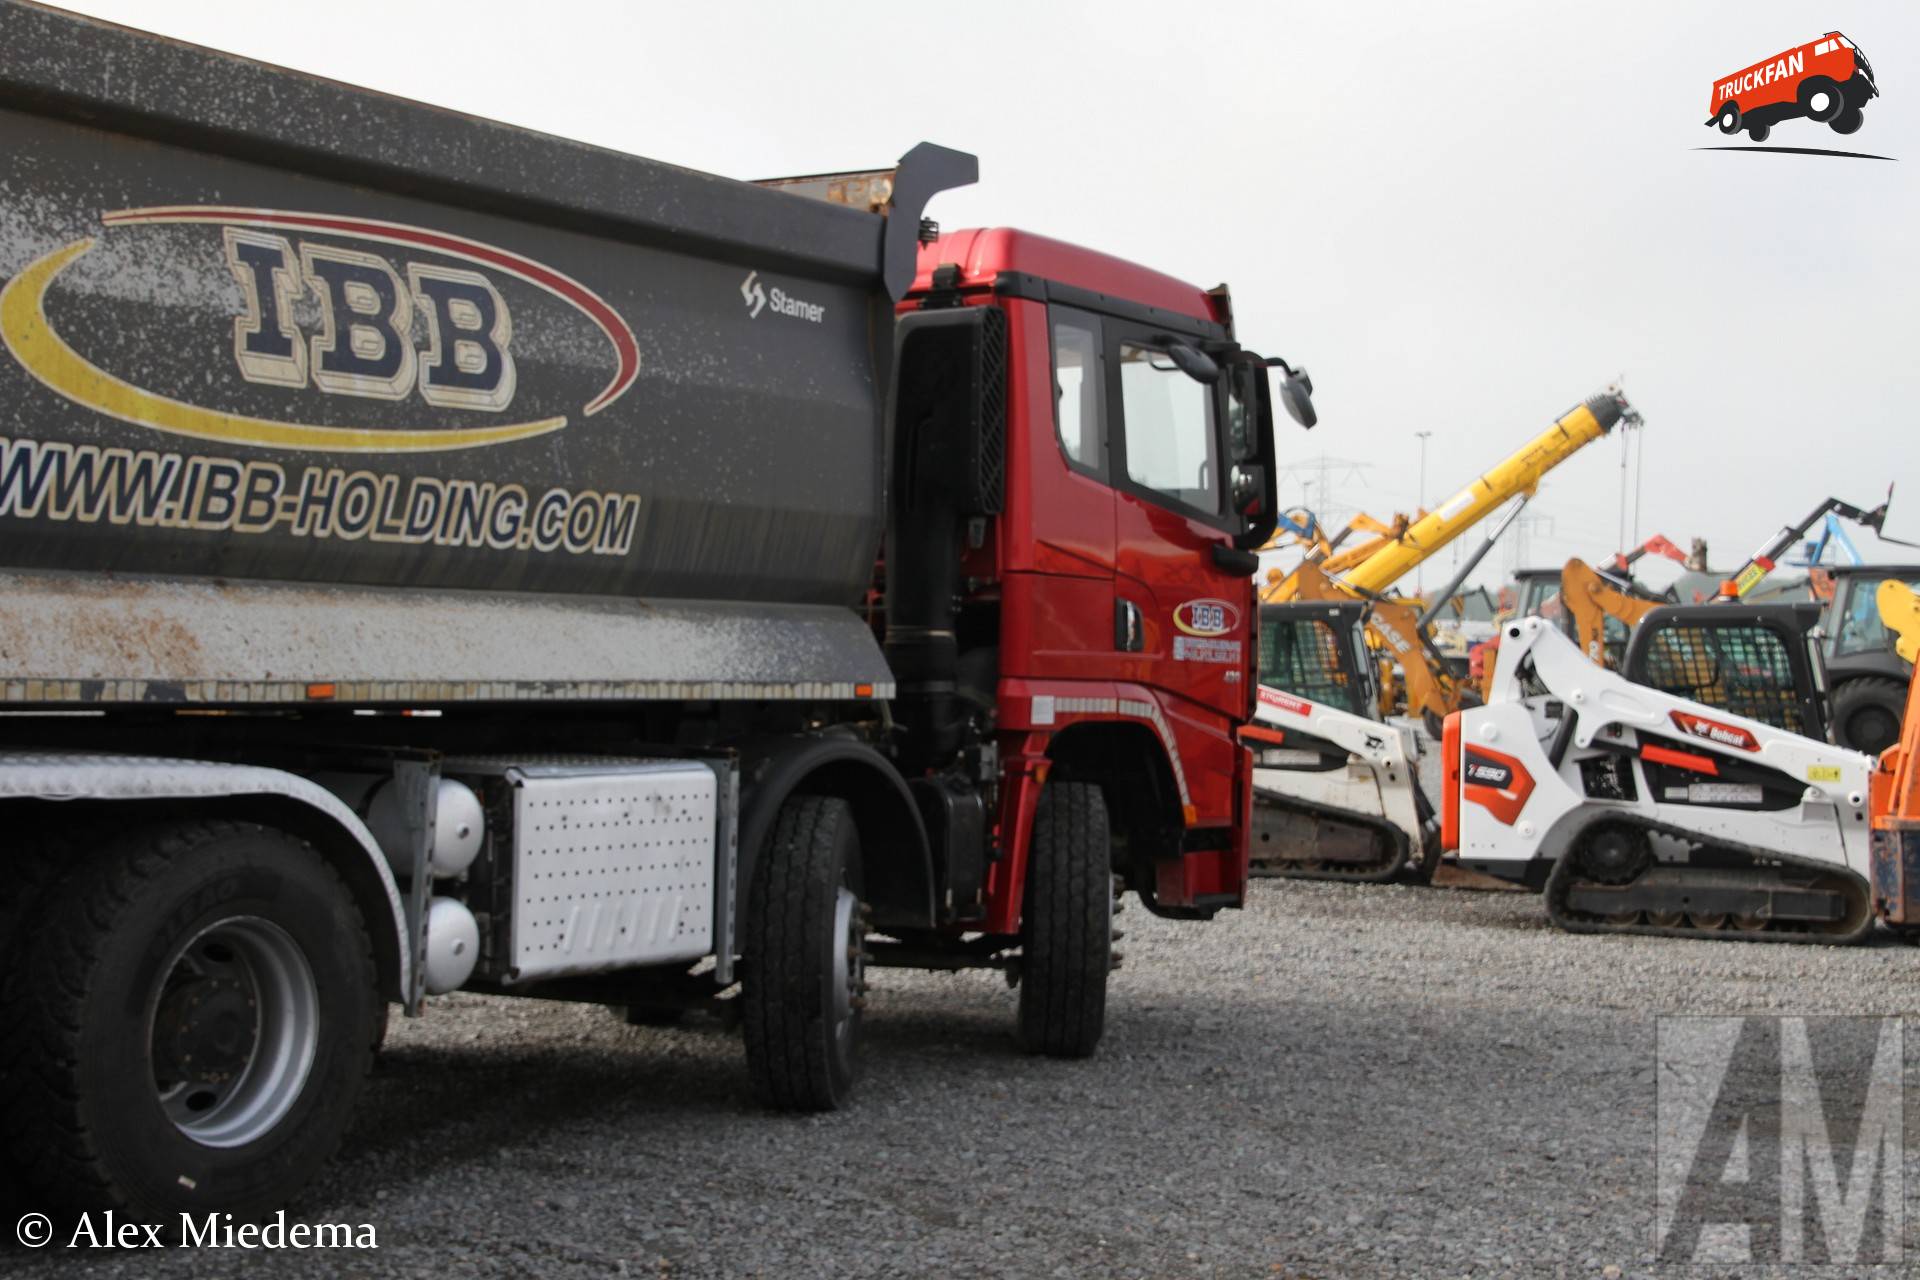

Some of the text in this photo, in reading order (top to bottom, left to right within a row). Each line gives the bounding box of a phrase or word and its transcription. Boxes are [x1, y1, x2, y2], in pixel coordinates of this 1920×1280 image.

[224, 226, 516, 412] IBB
[769, 287, 825, 323] Stamer
[0, 437, 641, 555] WWW.IBB-HOLDING.COM
